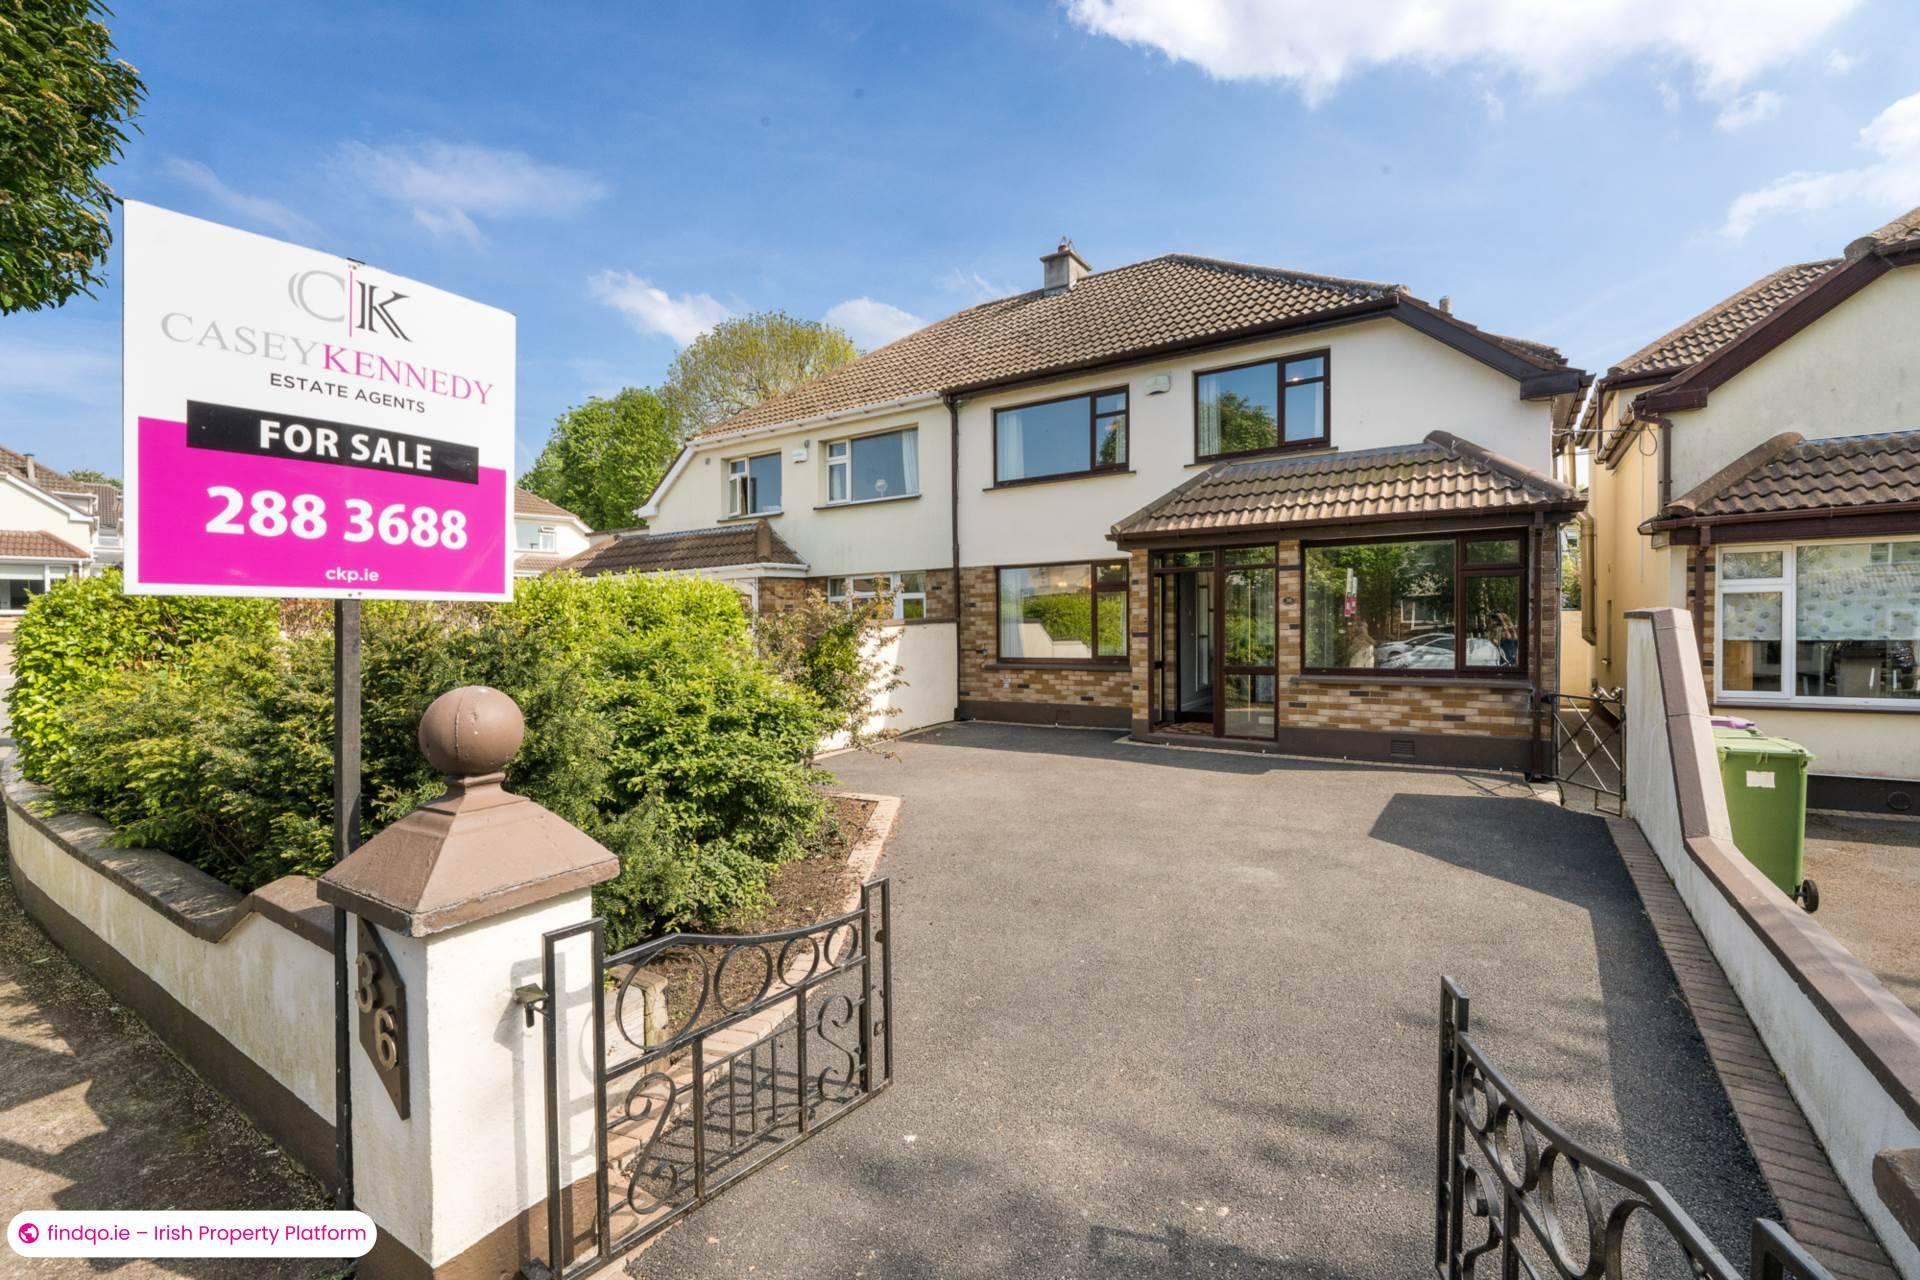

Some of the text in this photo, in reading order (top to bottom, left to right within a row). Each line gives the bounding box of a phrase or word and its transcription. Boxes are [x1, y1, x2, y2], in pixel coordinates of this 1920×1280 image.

[269, 372, 426, 414] ESTATE AGENTS
[259, 418, 433, 472] FOR SALE
[204, 485, 468, 551] 288 3688
[325, 566, 380, 584] ckp.ie
[355, 951, 398, 1072] 36
